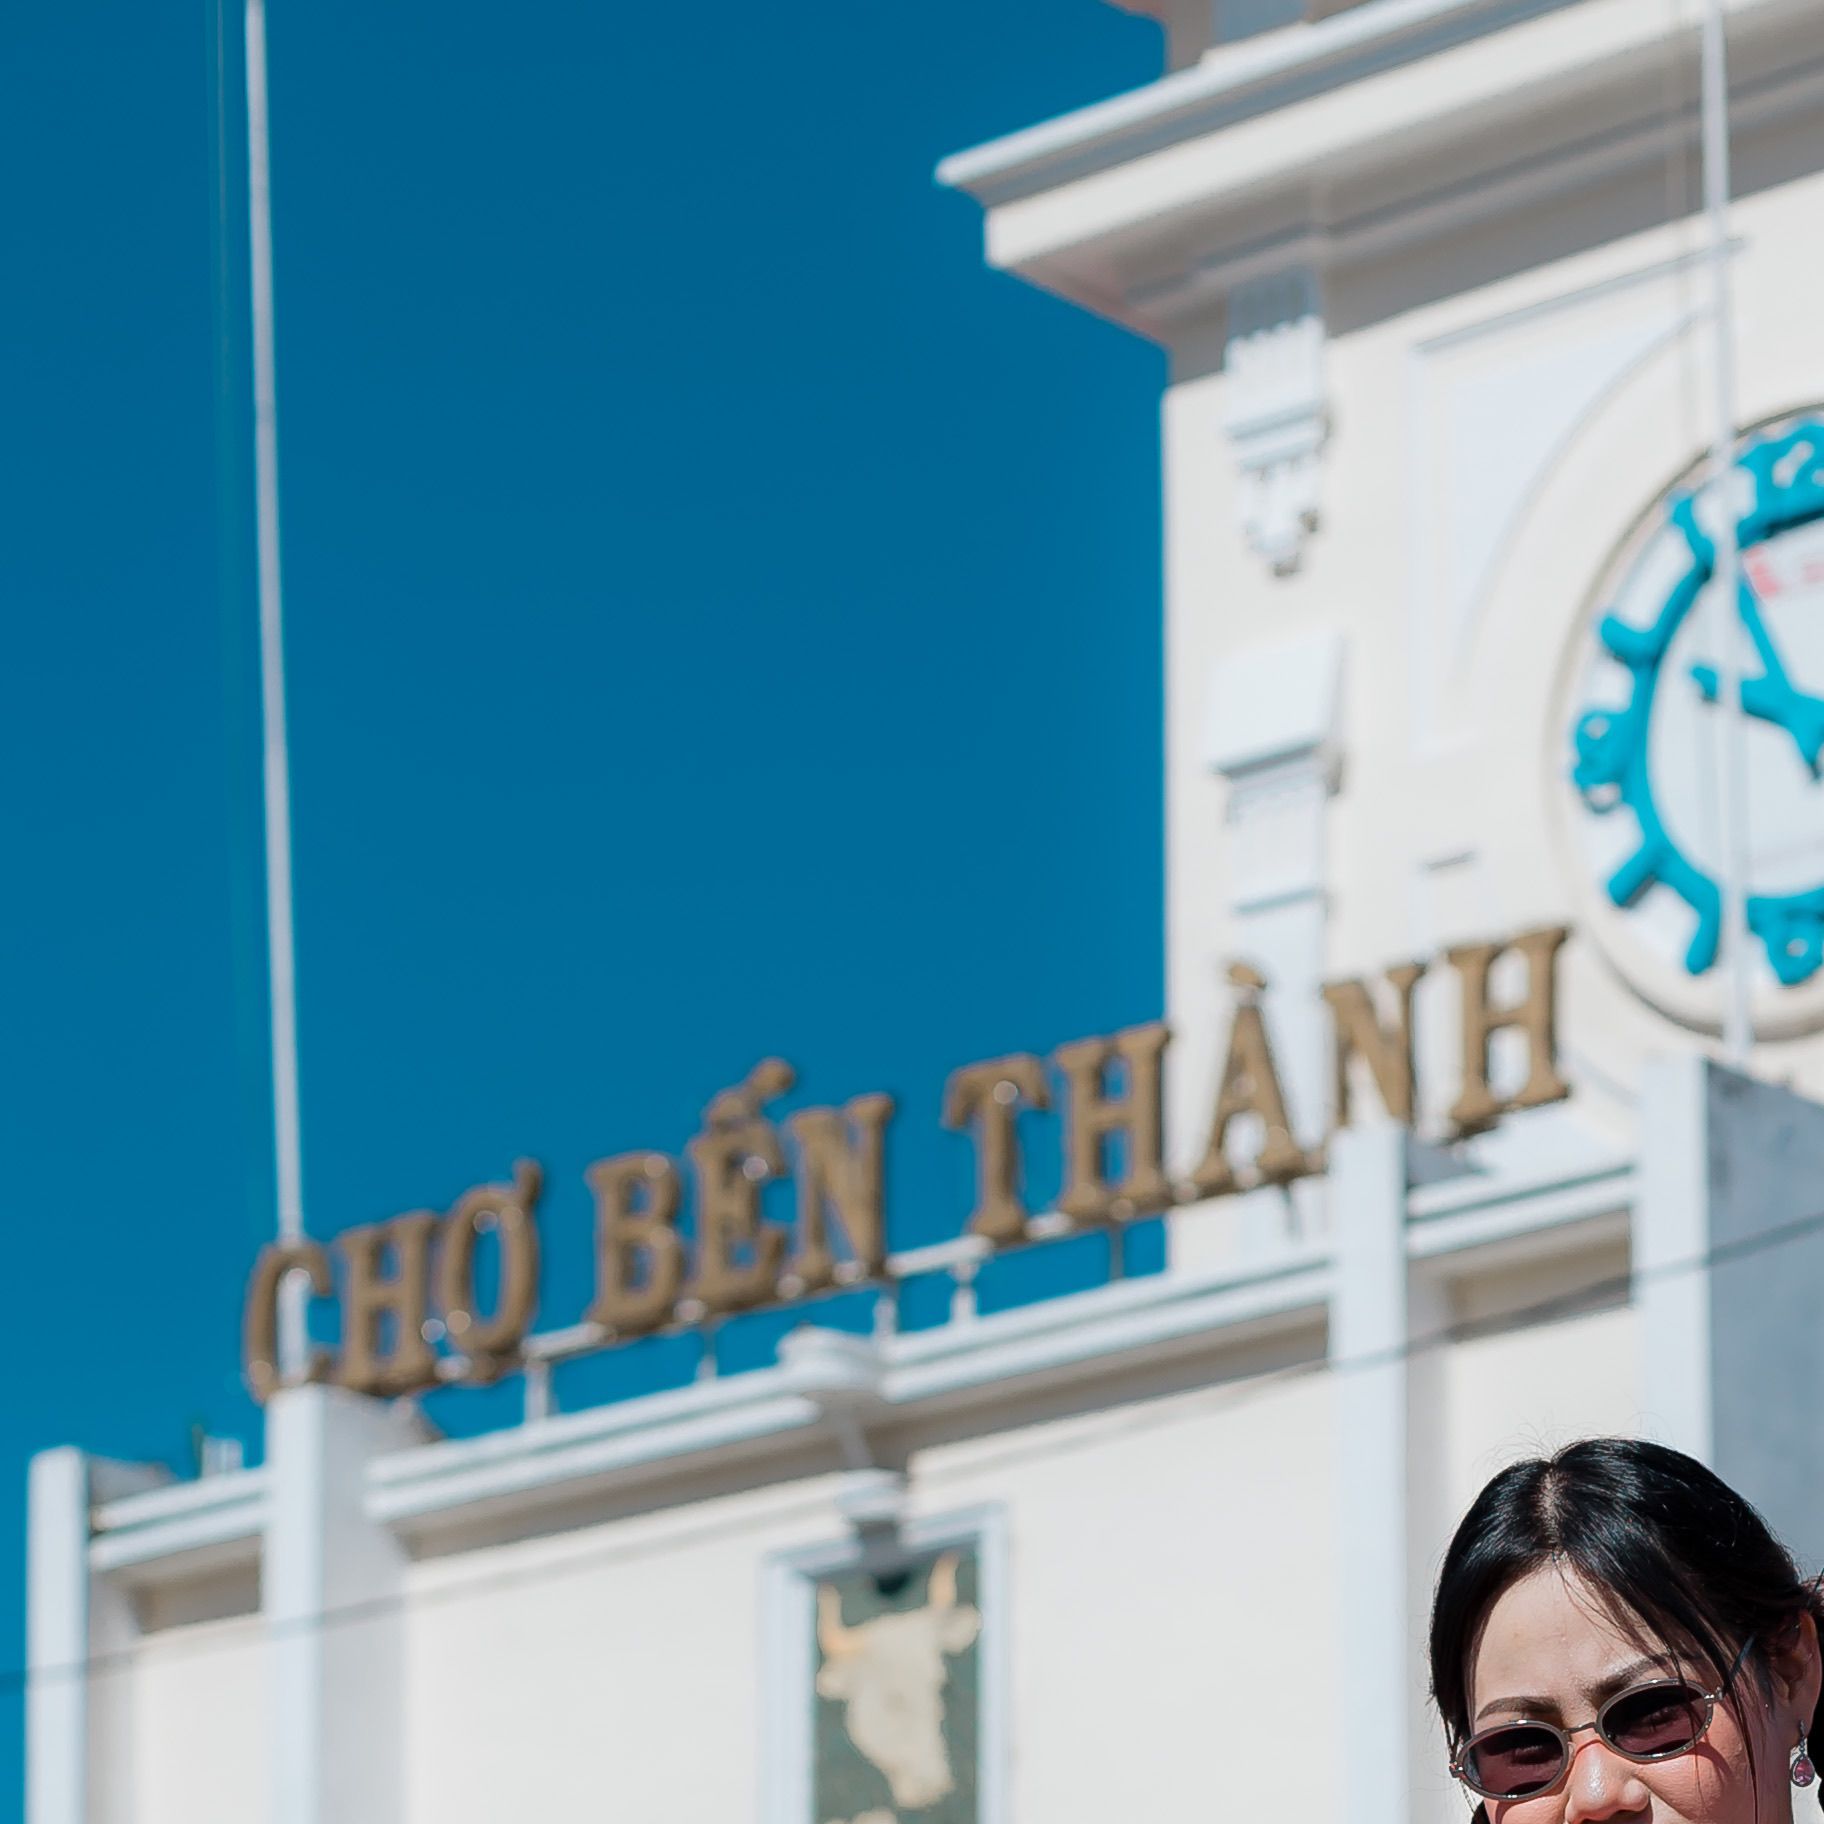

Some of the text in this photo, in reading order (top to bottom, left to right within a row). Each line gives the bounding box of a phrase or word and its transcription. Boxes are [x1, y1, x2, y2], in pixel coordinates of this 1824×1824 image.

[245, 925, 1572, 1402] CHỢ BẾN THÀNH
